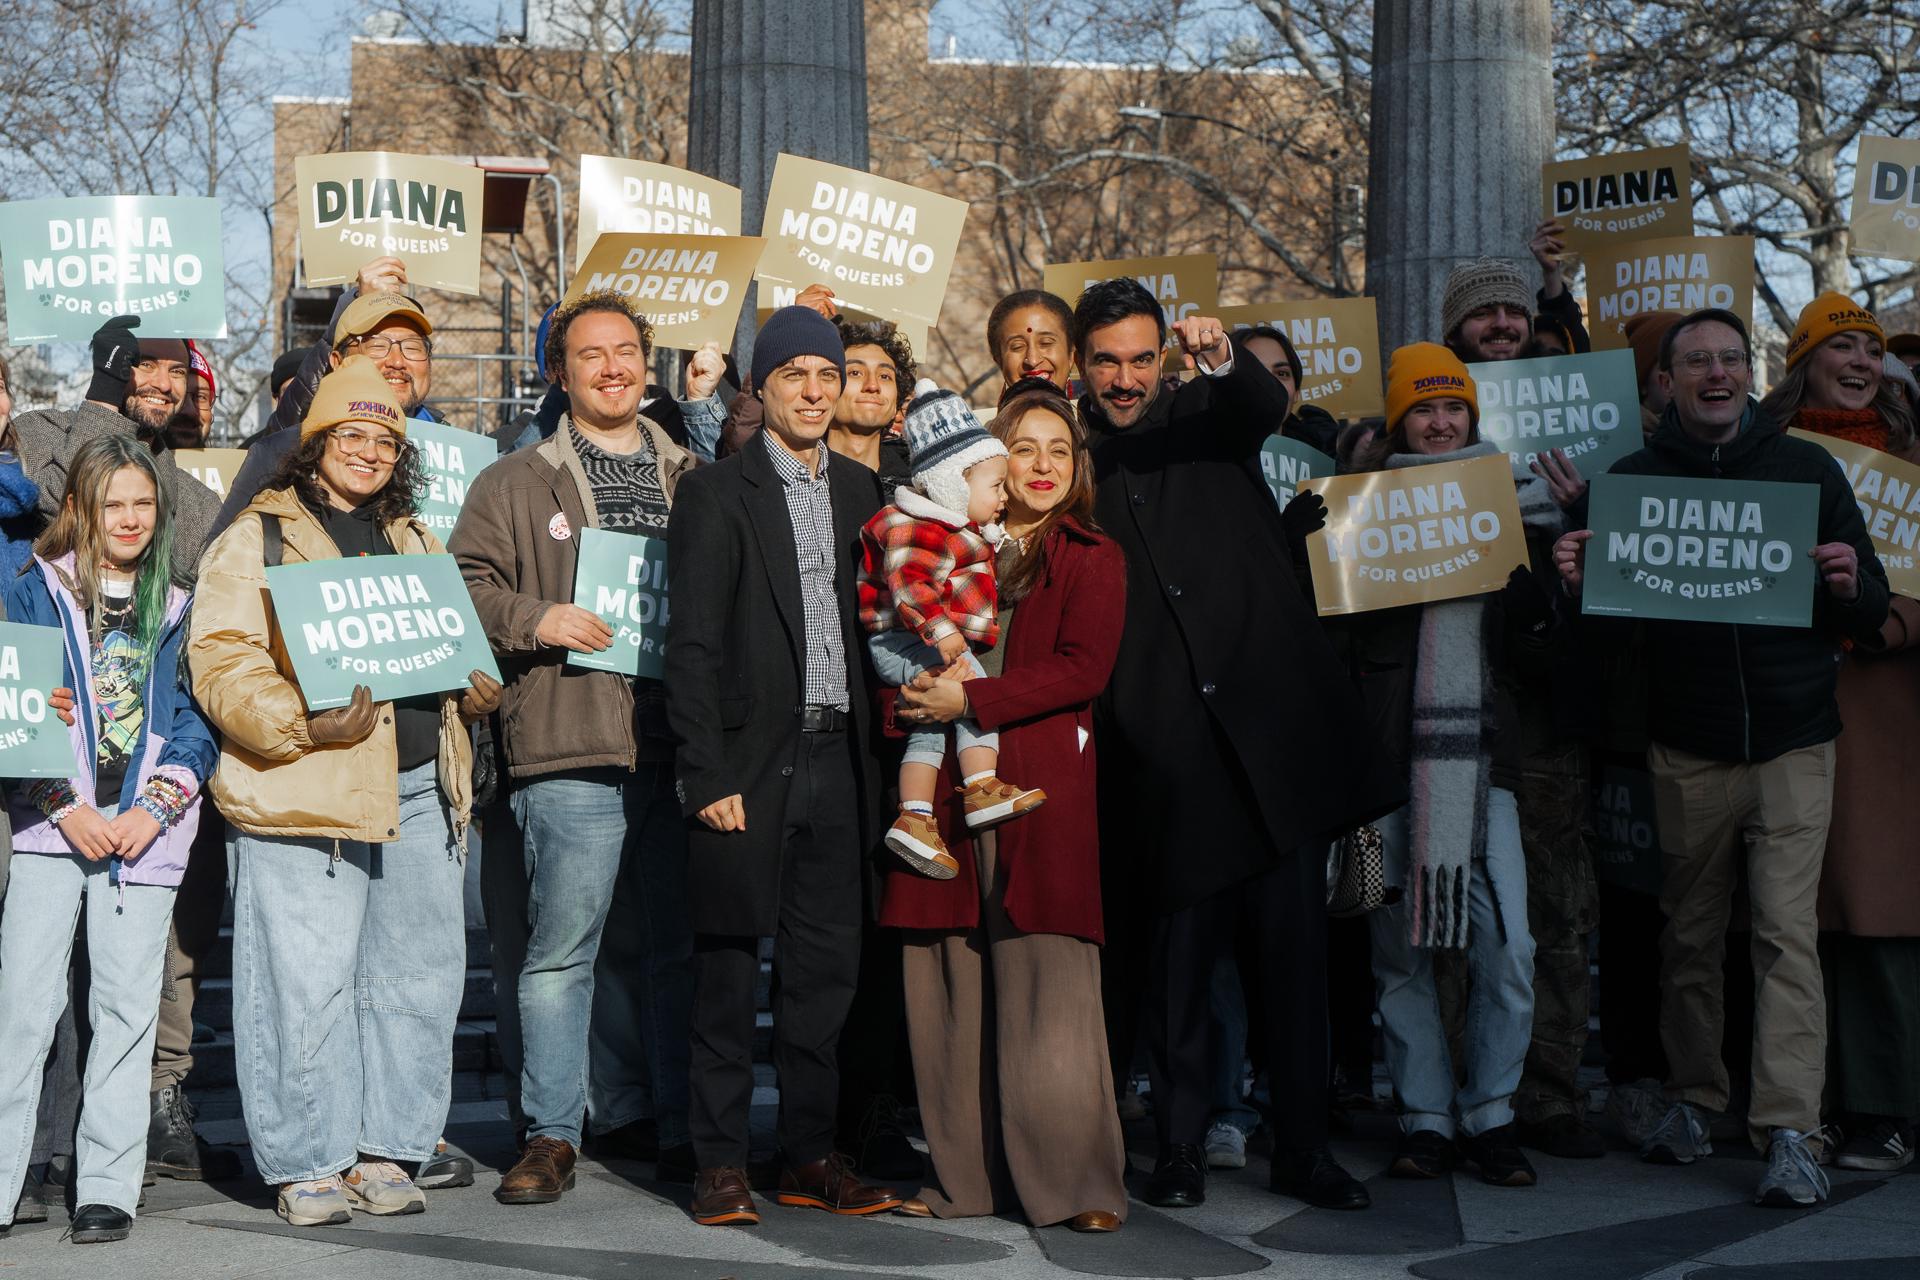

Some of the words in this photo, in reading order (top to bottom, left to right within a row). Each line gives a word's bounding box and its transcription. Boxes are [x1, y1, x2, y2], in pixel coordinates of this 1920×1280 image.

[313, 178, 467, 237] DIANA
[623, 176, 712, 219] DIANA
[811, 181, 917, 236] DIANA
[1554, 167, 1679, 217] DIANA
[49, 217, 173, 250] DIANA
[1573, 217, 1602, 232] FOR
[1606, 207, 1666, 232] QUEENS
[339, 228, 376, 248] FOR
[382, 236, 449, 254] QUEENS
[779, 208, 935, 274] MORENO
[23, 253, 203, 290] MORENO
[621, 248, 718, 275] DIANA
[797, 246, 831, 272] FOR
[834, 264, 904, 287] QUEENS
[1616, 253, 1709, 288] DIANA
[54, 293, 92, 315] FOR
[98, 291, 178, 317] QUEENS
[584, 272, 730, 307] MORENO
[1599, 283, 1735, 322] MORENO
[1296, 346, 1363, 376] ENO
[1301, 379, 1343, 402] EENS
[1413, 375, 1465, 391] ZOHRAN
[1478, 372, 1590, 408] DIANA
[348, 400, 399, 421] ZOHRAN
[1486, 402, 1620, 442] ORENO
[1260, 451, 1311, 485] ANA
[1348, 481, 1467, 525] DIANA
[1639, 496, 1764, 534] DIANA
[1326, 511, 1501, 563] MORENO
[1607, 531, 1793, 573] MORENO
[1358, 565, 1397, 582] FOR
[1402, 548, 1480, 583] QUEENS
[319, 574, 432, 613] DIANA
[1633, 569, 1673, 595] FOR
[1679, 577, 1764, 600] QUEENS
[302, 607, 465, 655] MORENO
[618, 625, 655, 653] FOR
[341, 655, 380, 674] FOR
[386, 642, 454, 675] QUEENS
